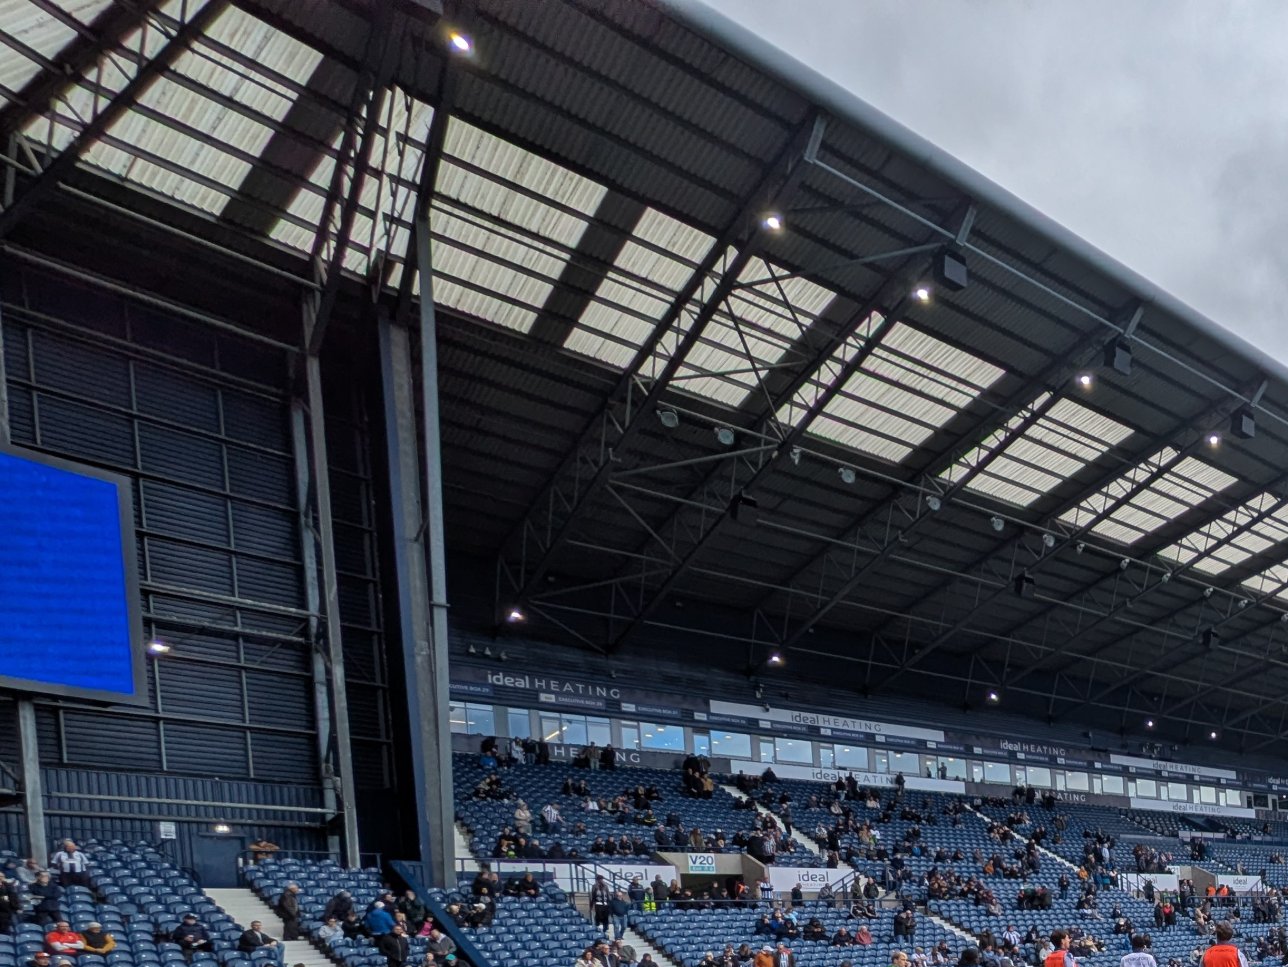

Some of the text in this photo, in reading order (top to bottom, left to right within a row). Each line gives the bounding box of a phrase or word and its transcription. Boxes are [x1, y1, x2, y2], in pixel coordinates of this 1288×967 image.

[449, 683, 468, 691] CUTIVE
[487, 670, 621, 699] ideal HEATING
[791, 712, 882, 733] ideal HEATING
[1000, 739, 1020, 751] ideal
[1022, 744, 1066, 756] HEATING
[554, 746, 641, 764] HENG
[1152, 762, 1201, 773] ideal HEATING
[1172, 802, 1222, 814] ideal HEATING
[690, 855, 714, 866] V20
[798, 870, 829, 882] ideal
